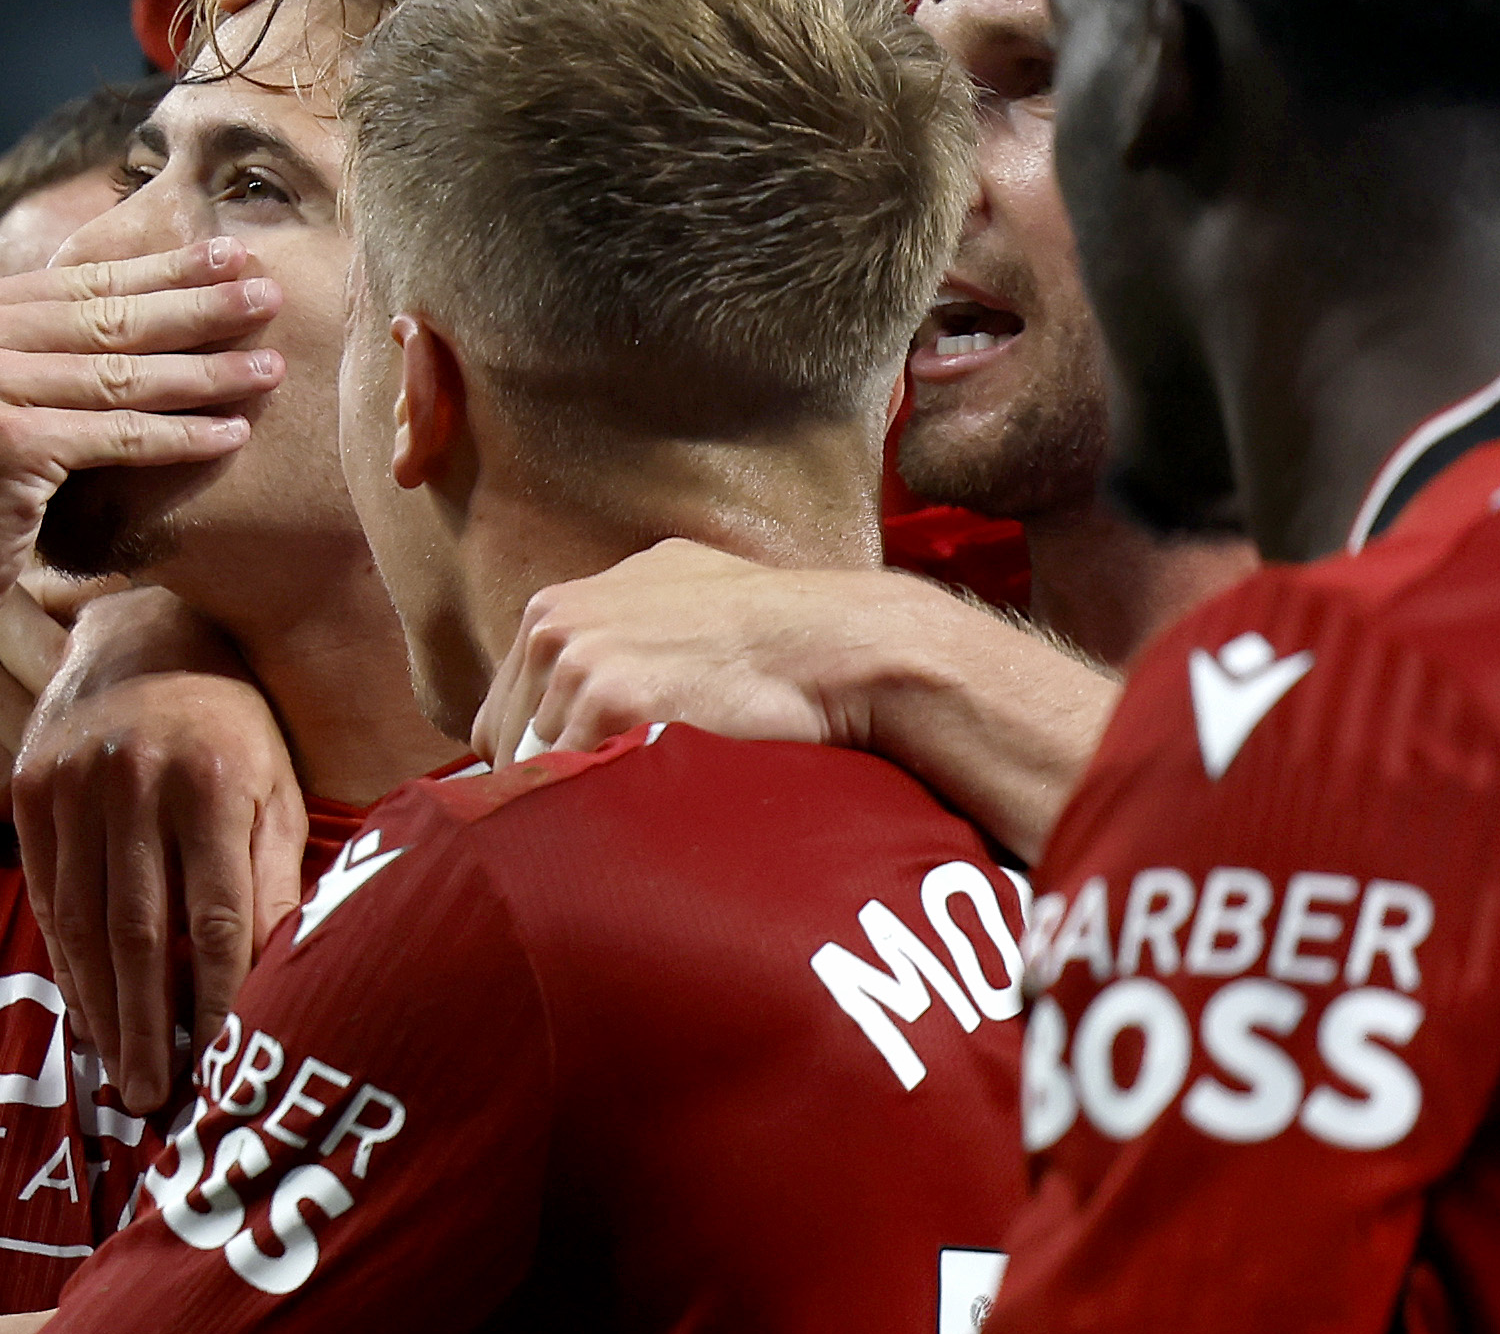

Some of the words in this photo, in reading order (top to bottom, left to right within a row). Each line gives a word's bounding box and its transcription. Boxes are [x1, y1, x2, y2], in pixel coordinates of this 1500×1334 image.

[808, 860, 1035, 1093] MO
[1020, 975, 1426, 1153] BOSS
[193, 1011, 407, 1180] RBER
